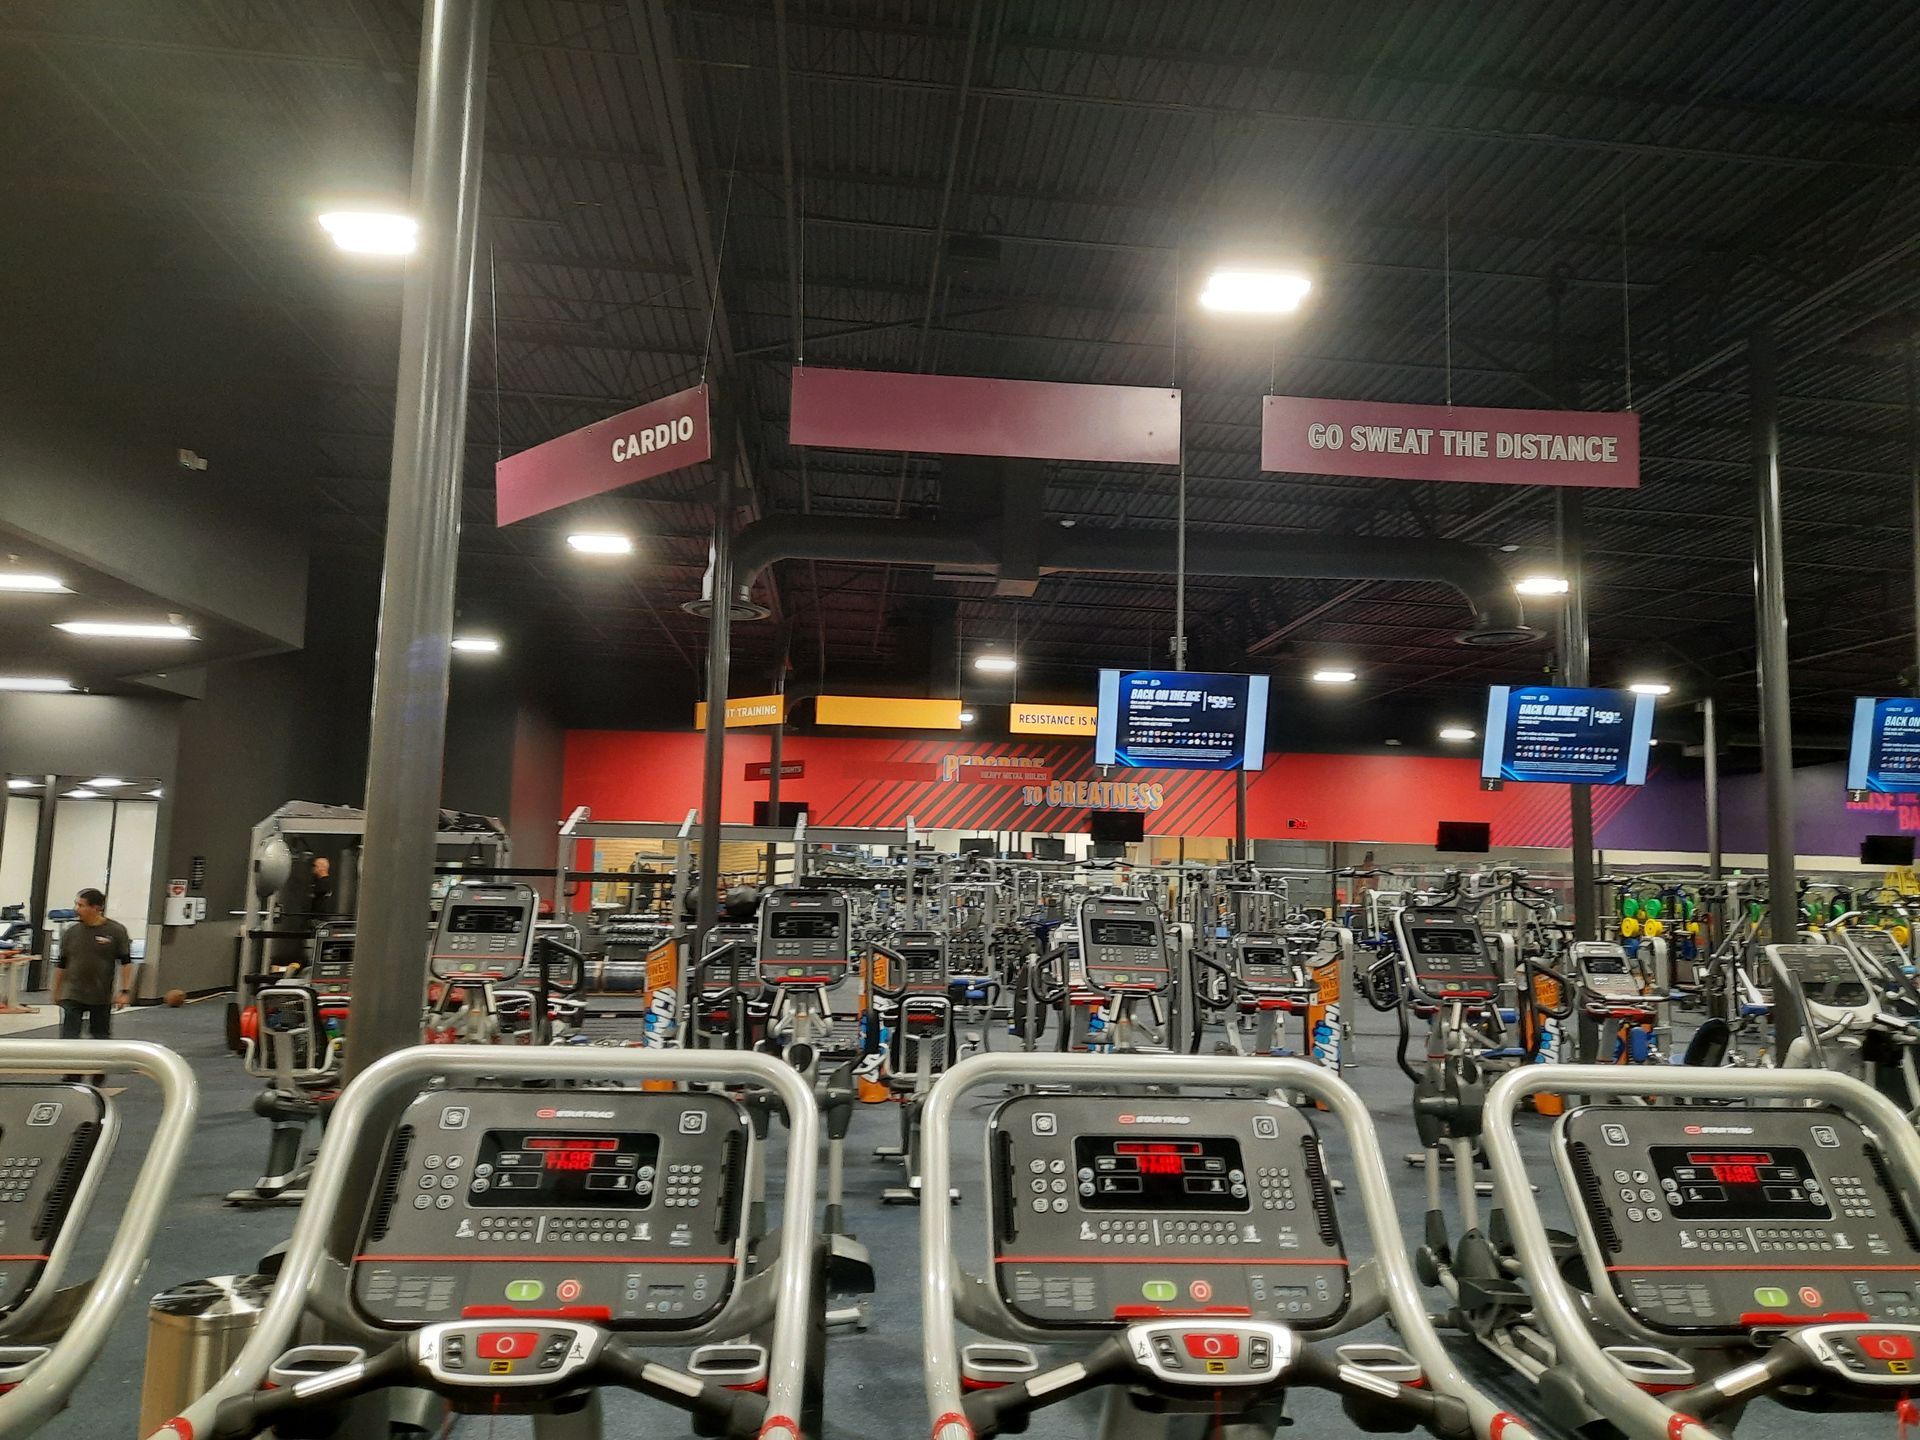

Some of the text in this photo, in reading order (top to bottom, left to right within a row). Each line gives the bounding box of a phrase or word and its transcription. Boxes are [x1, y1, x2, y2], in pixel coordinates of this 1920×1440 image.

[612, 416, 694, 463] CARDIO
[1308, 423, 1618, 463] GO SWEAT THE DISTANCE
[1130, 688, 1155, 701] BACK
[1155, 689, 1169, 701] ON
[1169, 689, 1187, 702] THE
[737, 705, 777, 718] TRAINING
[1519, 704, 1544, 715] BACK
[1019, 714, 1075, 725] RESISTANCE
[1079, 716, 1087, 725] IS
[1884, 715, 1908, 727] BACK
[1487, 782, 1494, 791] 2
[1023, 779, 1164, 811] TO GREATNESS
[1853, 793, 1860, 802] 3
